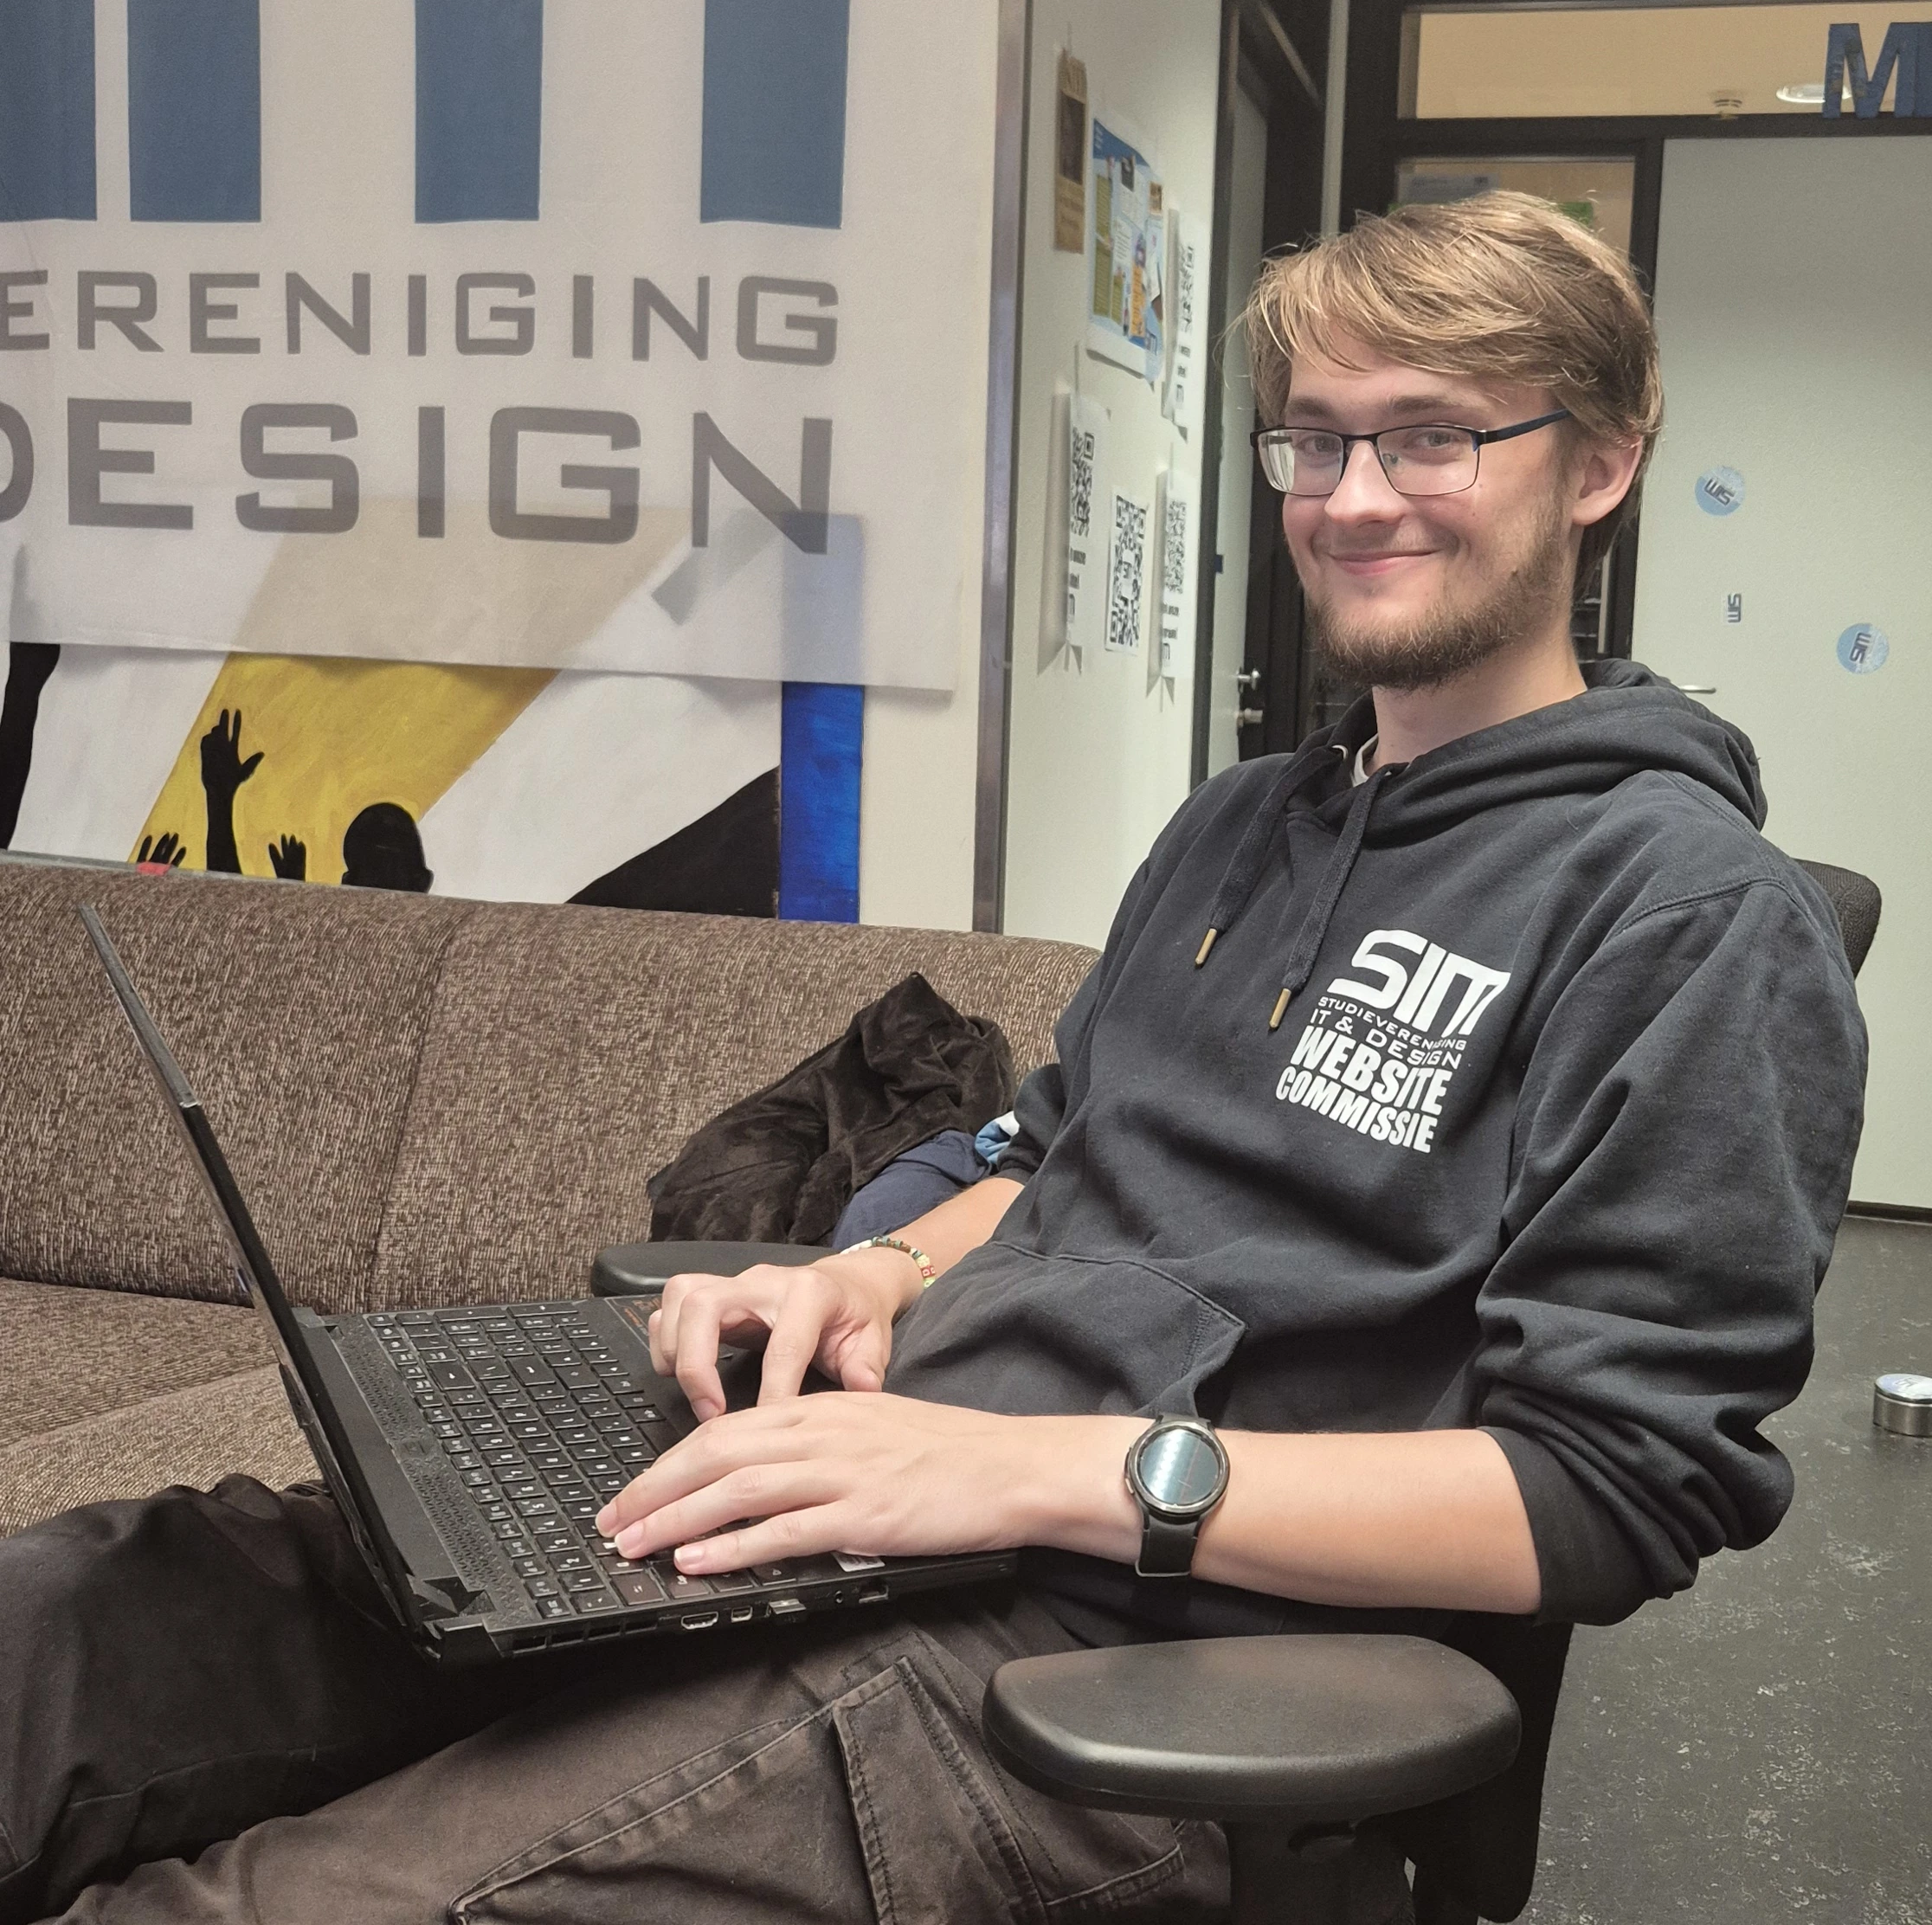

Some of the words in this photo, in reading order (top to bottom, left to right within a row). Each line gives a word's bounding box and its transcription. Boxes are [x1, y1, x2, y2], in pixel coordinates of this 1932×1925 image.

[0, 396, 834, 555] ESIGN
[1326, 929, 1512, 1039] SIM
[1290, 1025, 1453, 1116] WEBSITE
[1310, 1008, 1332, 1025] IT
[1334, 1015, 1354, 1035] &
[1365, 1027, 1463, 1070] DESIGN
[1275, 1066, 1439, 1154] COMMISSIE
